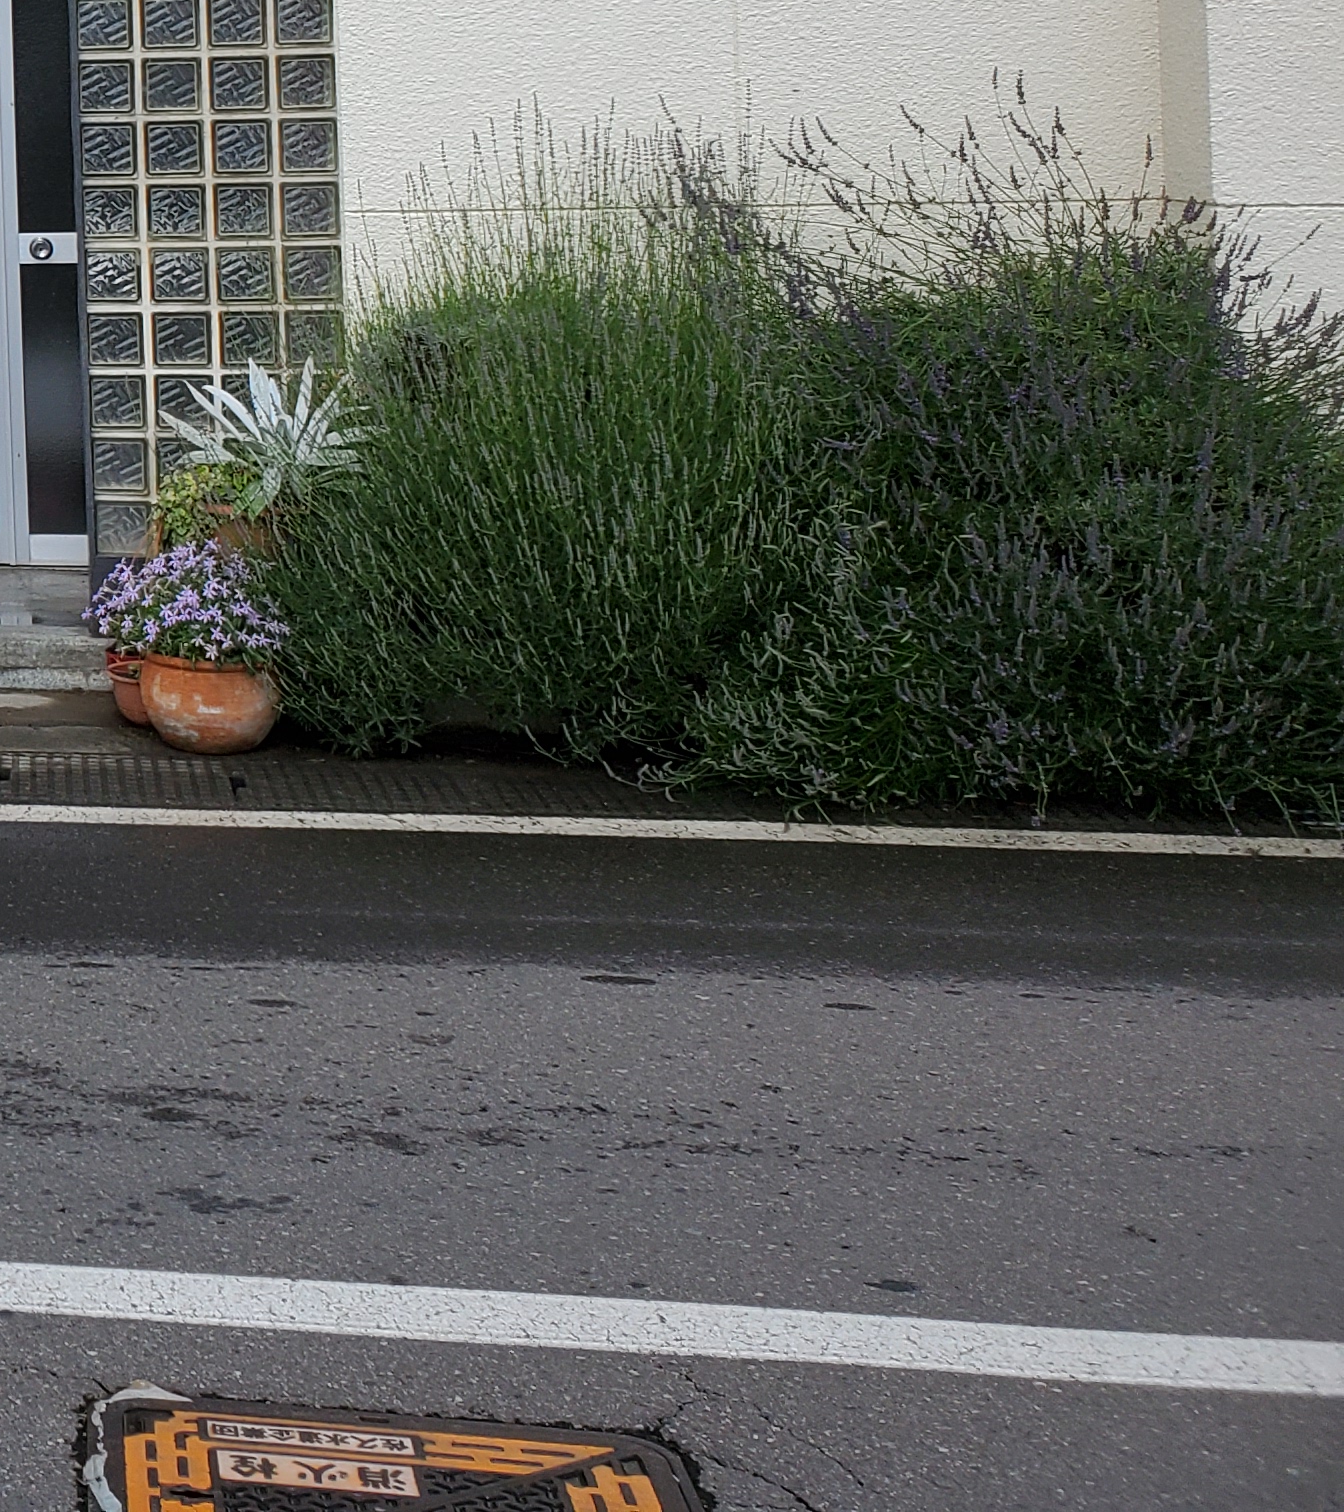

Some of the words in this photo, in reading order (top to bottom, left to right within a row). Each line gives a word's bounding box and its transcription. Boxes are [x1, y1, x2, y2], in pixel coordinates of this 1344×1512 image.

[211, 1423, 409, 1451] 佐久水道企業団
[229, 1454, 407, 1491] 消火栓
